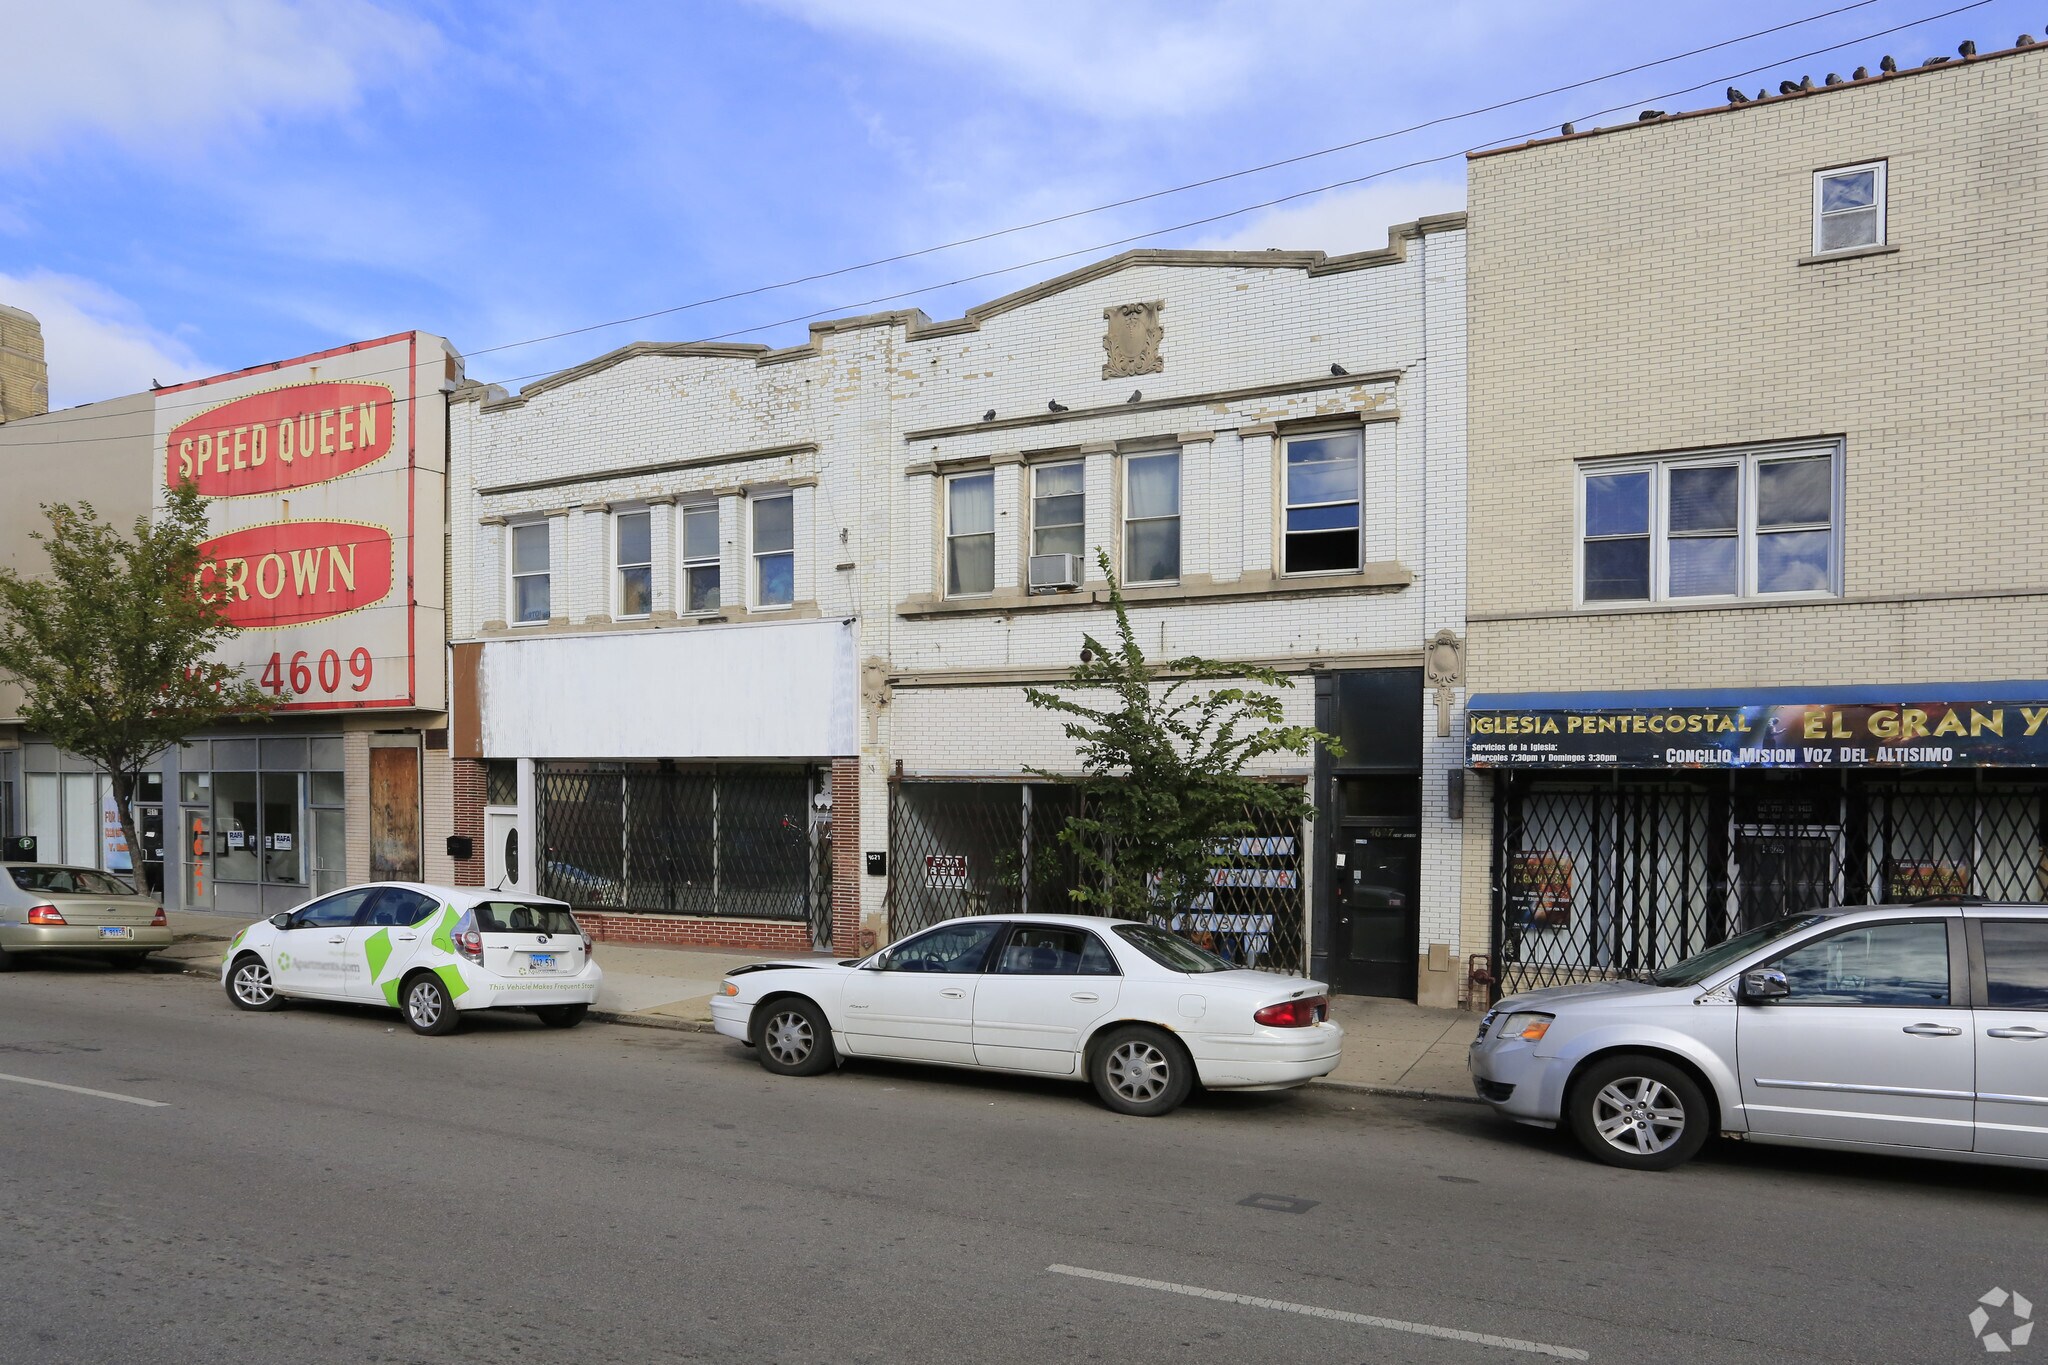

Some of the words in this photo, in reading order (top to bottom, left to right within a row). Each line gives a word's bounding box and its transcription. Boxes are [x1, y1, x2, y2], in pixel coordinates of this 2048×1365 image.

[179, 423, 267, 478] SPEED
[278, 401, 376, 465] QUEEN
[194, 544, 358, 604] CROWN
[260, 647, 373, 695] 4609
[1470, 716, 1560, 735] IGLESIA
[1567, 714, 1752, 734] PENTECOSTAL
[1803, 710, 1853, 739] EL
[1867, 708, 2004, 738] GRAN
[2021, 707, 2048, 736] Y
[1471, 743, 1506, 752] Servicios
[1509, 743, 1518, 752] de
[1520, 743, 1528, 752] la
[1530, 743, 1558, 752] Iglesia:
[1840, 747, 1870, 763] DEL
[1471, 753, 1508, 763] Miercoles
[1511, 754, 1538, 764] 7:30pm
[1540, 754, 1546, 764] y
[1548, 753, 1586, 764] Domingos
[1588, 754, 1618, 764] 3:30pm
[276, 835, 291, 843] RAFA
[554, 983, 581, 991] Frequent
